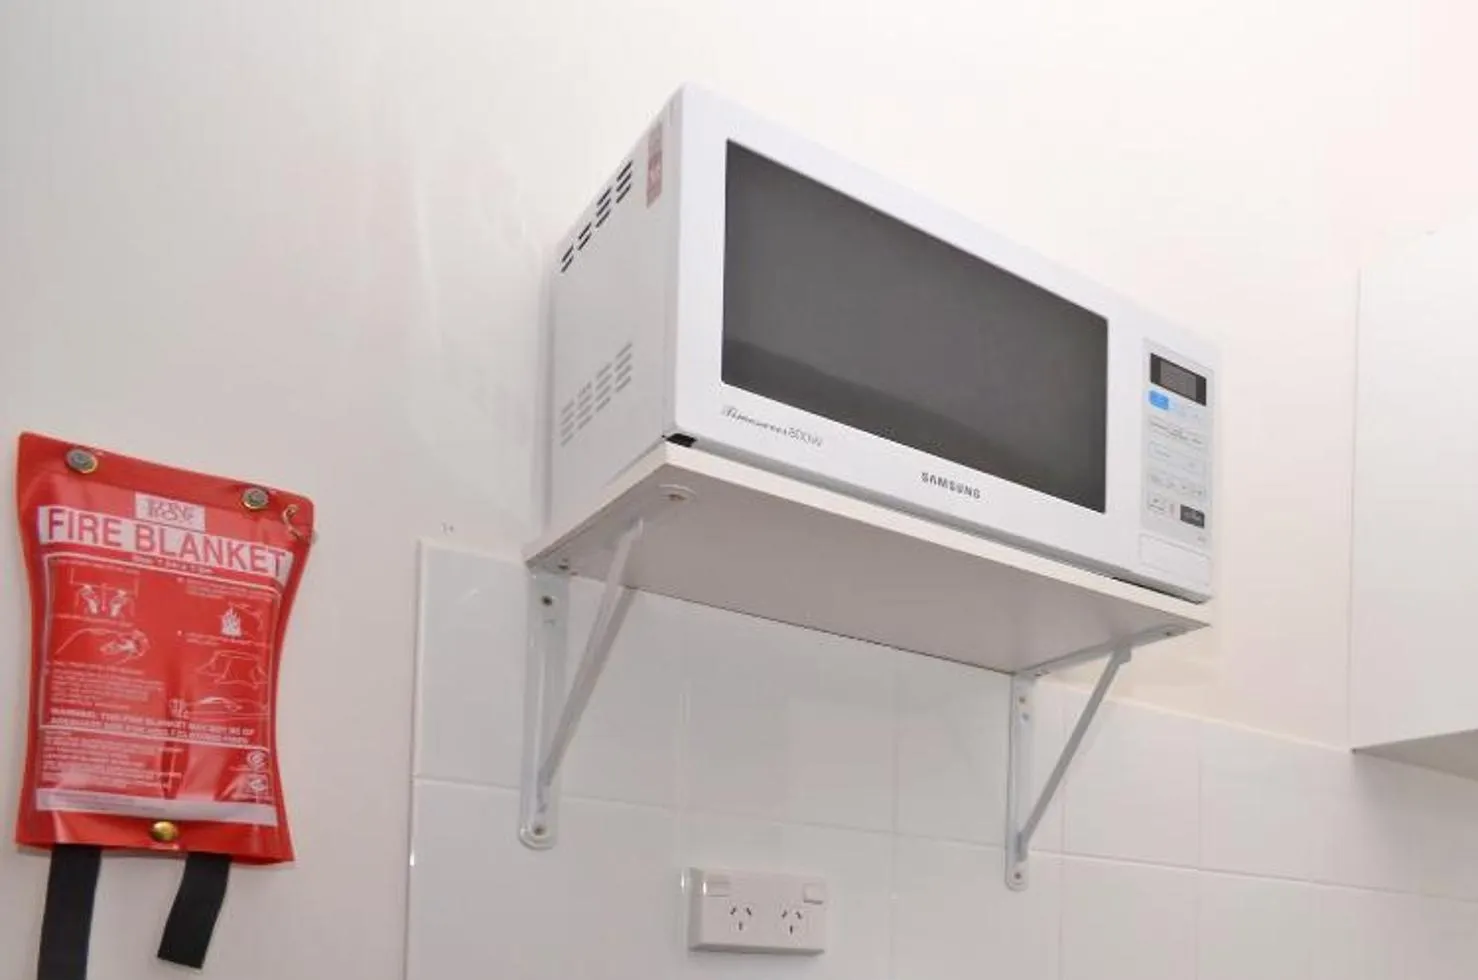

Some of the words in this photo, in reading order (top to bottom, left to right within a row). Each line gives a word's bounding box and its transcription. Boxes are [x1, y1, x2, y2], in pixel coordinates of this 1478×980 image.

[921, 471, 981, 500] SAMSUNG
[48, 507, 122, 547] FIRE
[134, 522, 286, 577] BLANKET
